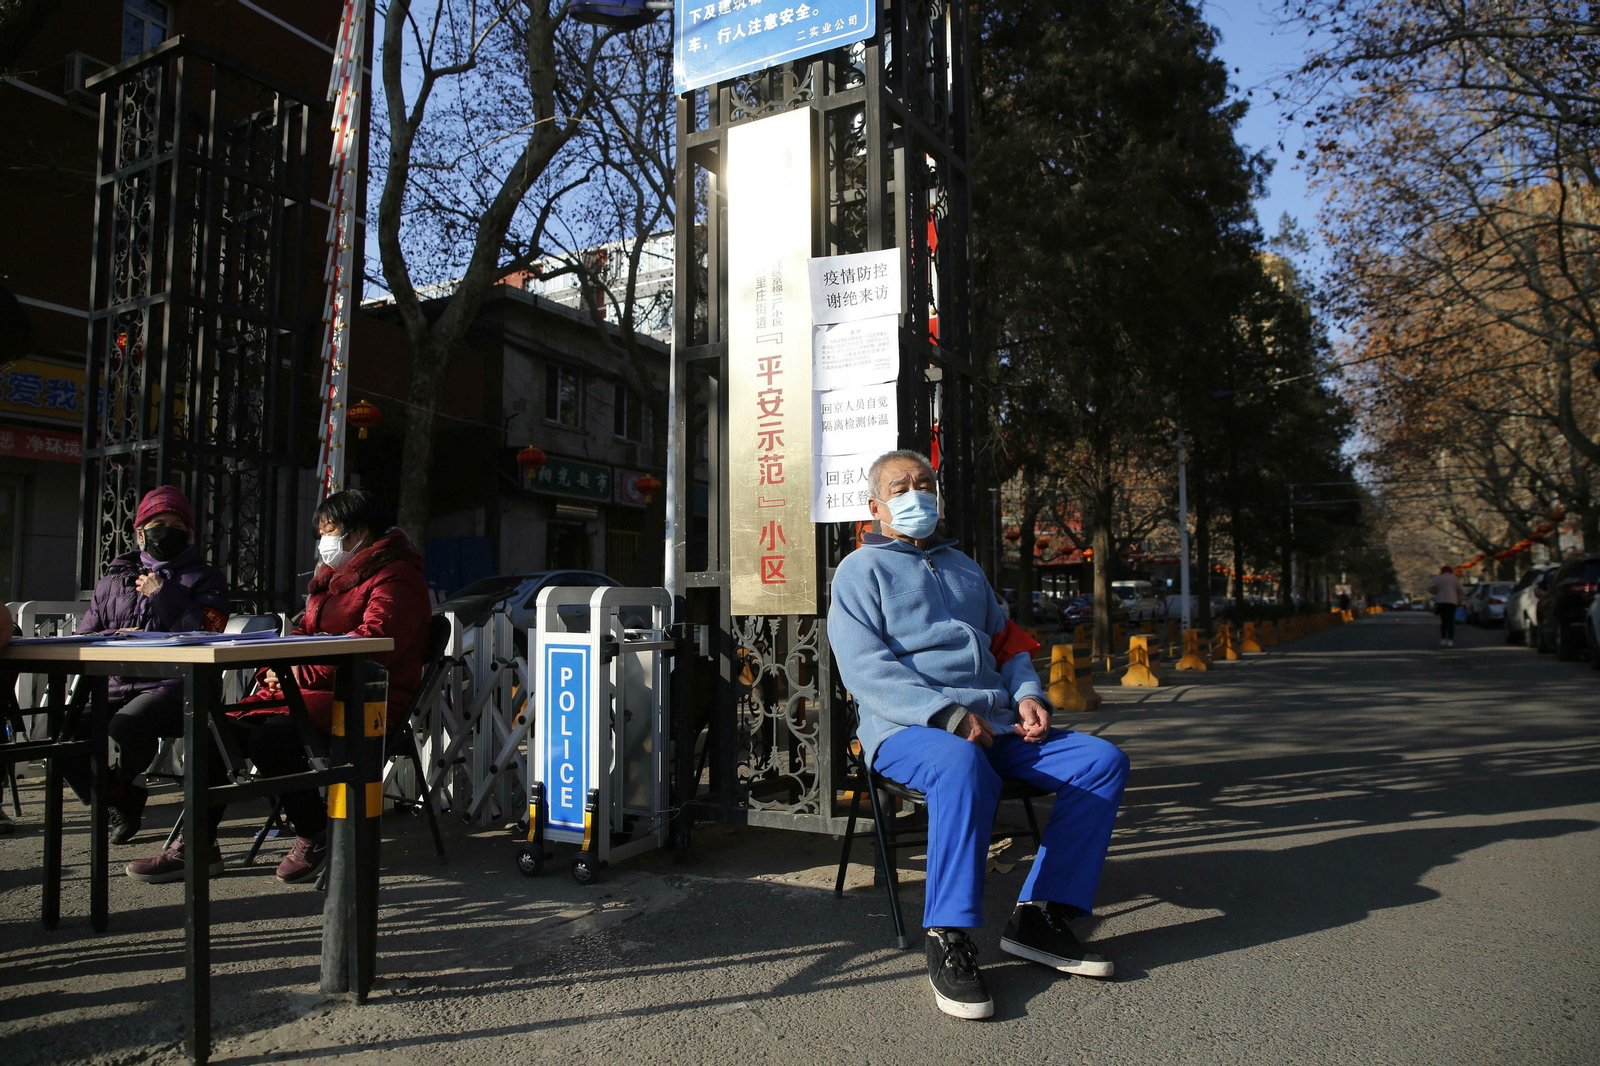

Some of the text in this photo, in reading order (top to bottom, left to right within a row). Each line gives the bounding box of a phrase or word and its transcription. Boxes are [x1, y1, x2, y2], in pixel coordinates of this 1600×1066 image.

[687, 3, 819, 54] 车，行人注意安全。
[823, 262, 888, 287] 疫情防控
[825, 285, 889, 309] 谢绝来访
[821, 396, 889, 415] 回京人员自觉
[821, 413, 889, 433] 隔离检测体温
[537, 465, 608, 493] 阳光超市
[825, 467, 869, 487] 回京人
[825, 490, 873, 510] 社区登
[558, 667, 575, 809] POLICE
